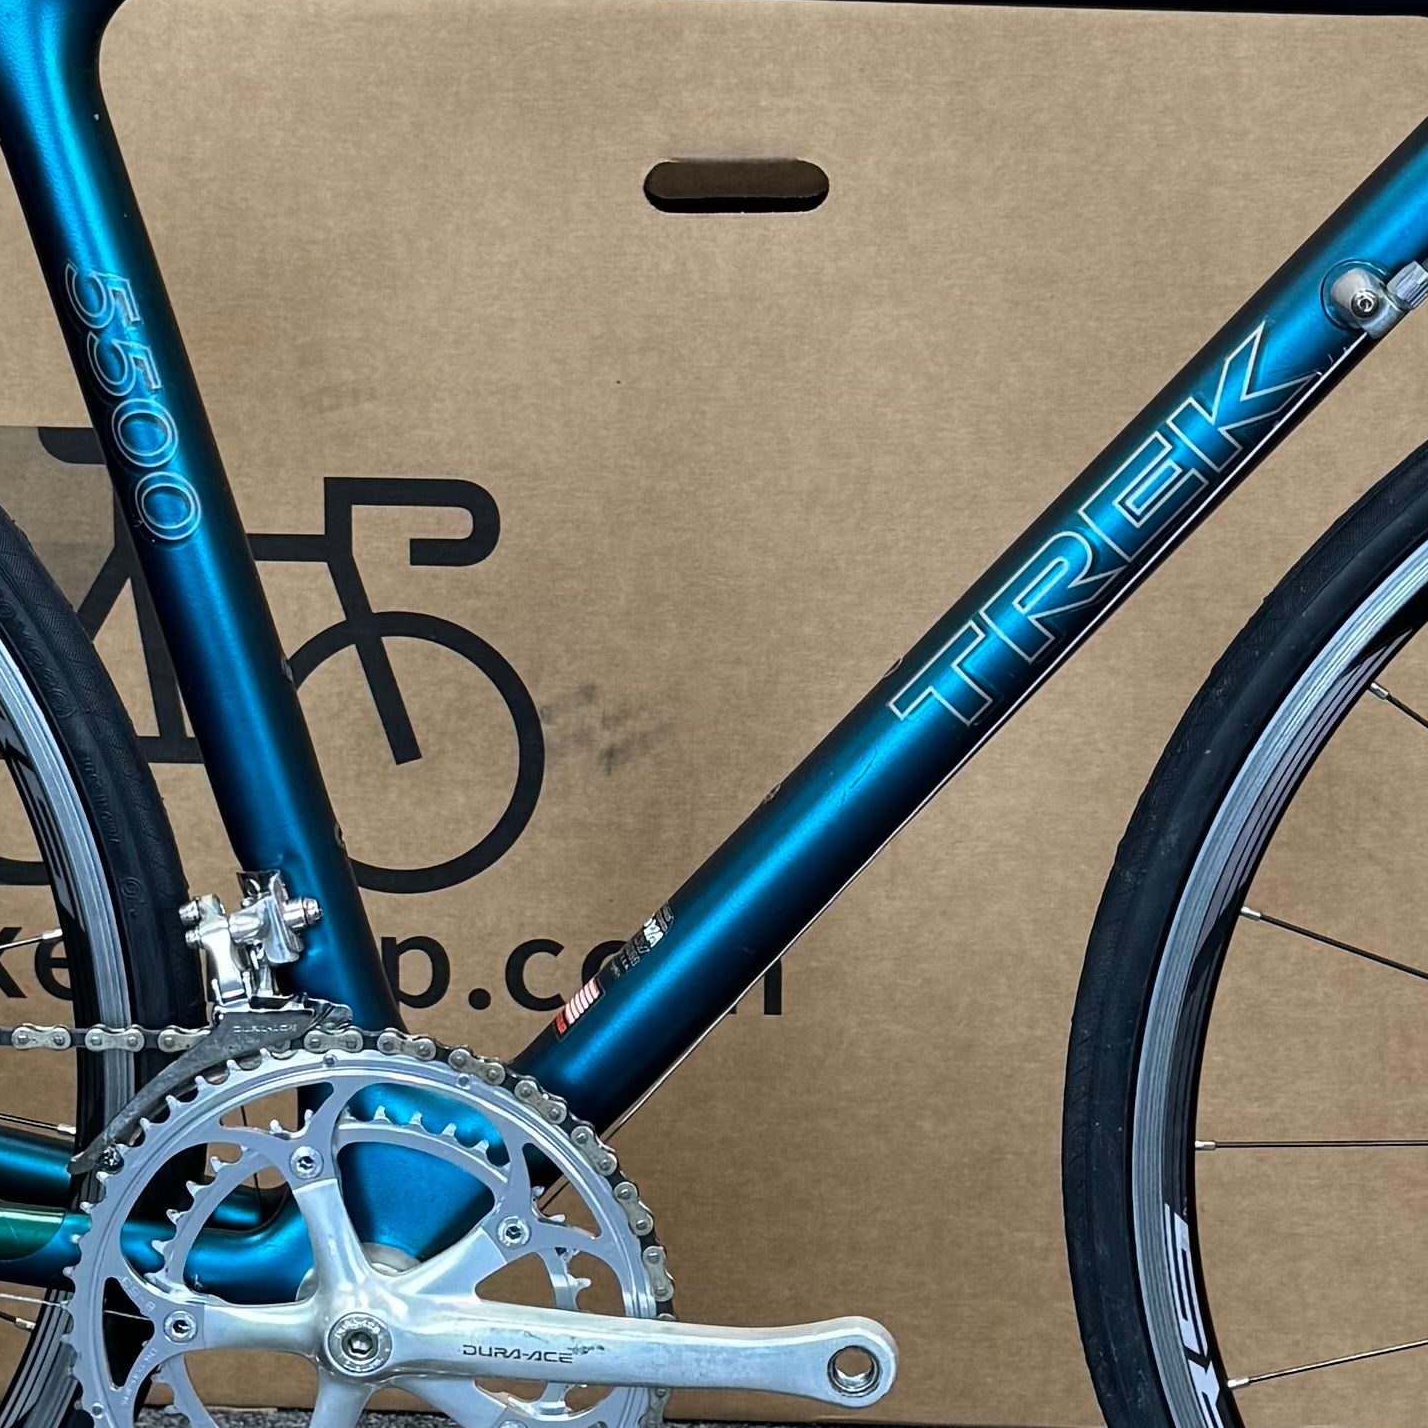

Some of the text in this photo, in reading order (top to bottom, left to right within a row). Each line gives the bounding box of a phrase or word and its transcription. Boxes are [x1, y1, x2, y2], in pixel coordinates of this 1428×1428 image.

[64, 259, 203, 541] 5500
[887, 320, 1321, 727] TREK
[461, 1343, 574, 1365] DURA-ACE
